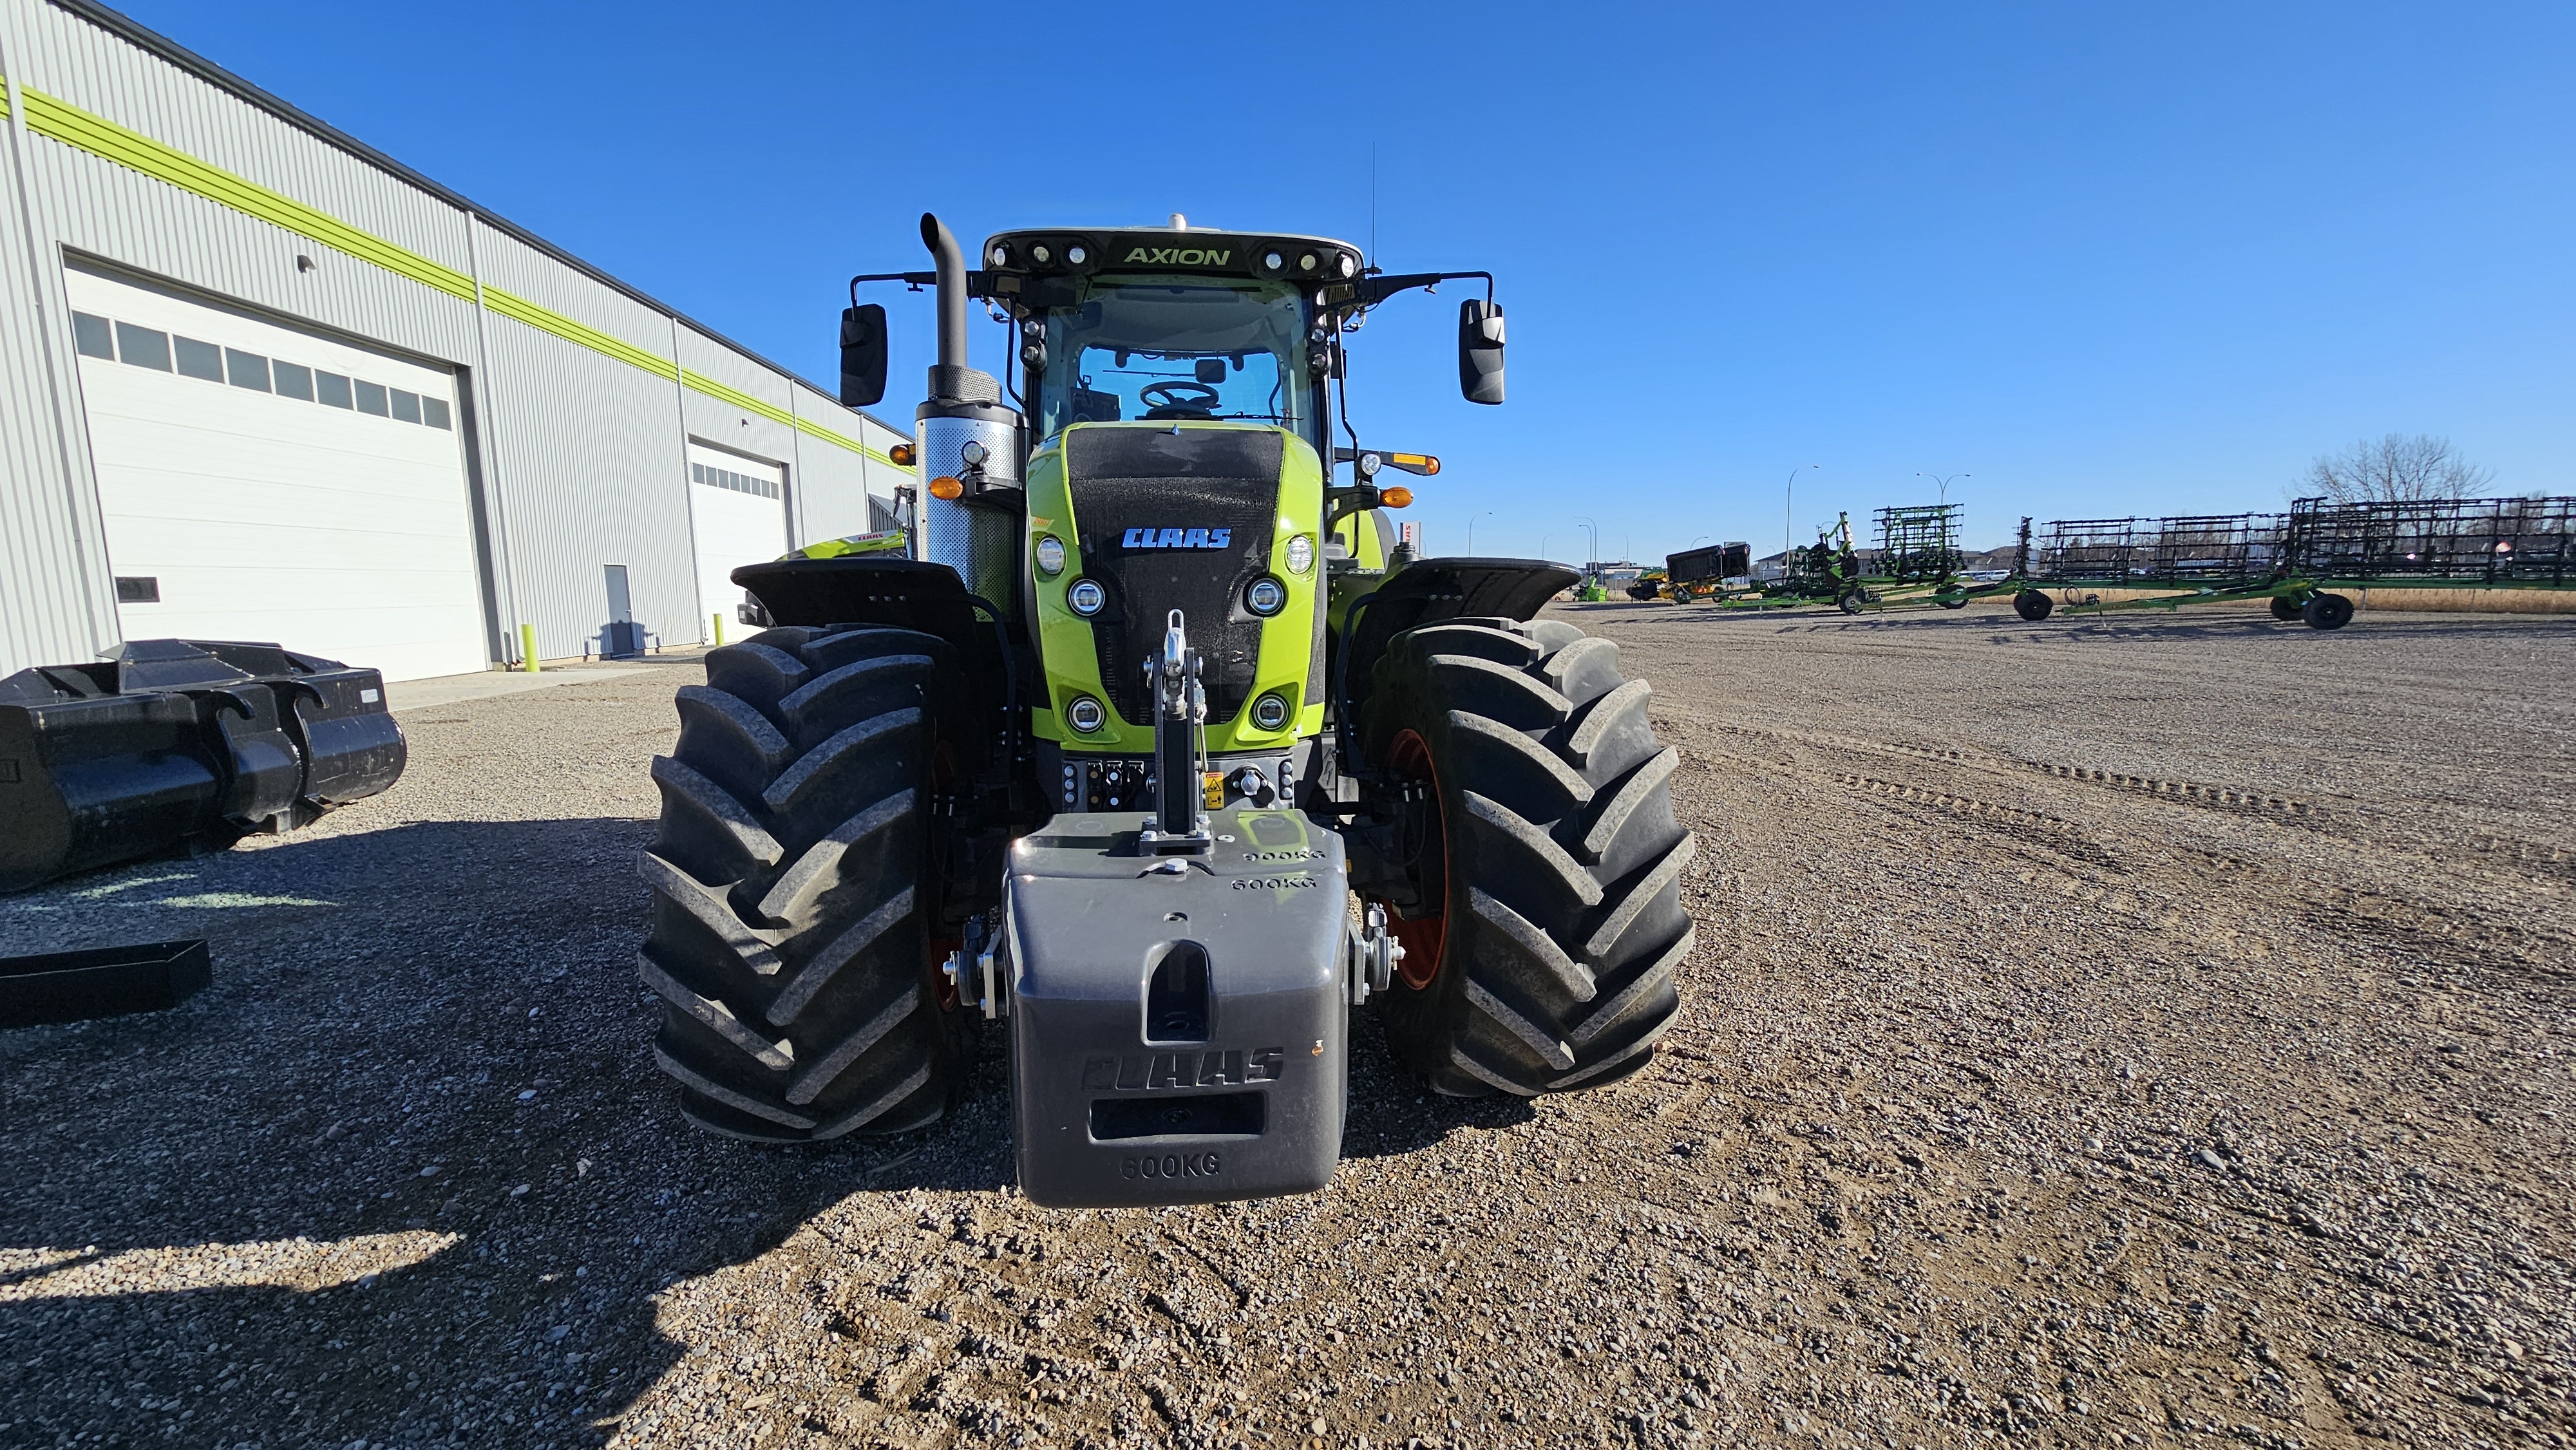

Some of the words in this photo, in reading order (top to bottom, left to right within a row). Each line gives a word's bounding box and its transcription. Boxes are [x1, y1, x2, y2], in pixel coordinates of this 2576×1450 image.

[1123, 247, 1231, 265] AXION
[1122, 528, 1231, 548] CLAAS
[1243, 851, 1326, 862] 900KG
[1231, 878, 1317, 890] 600KG
[1081, 1047, 1284, 1090] CLAAS
[1120, 1151, 1220, 1180] 600KG
